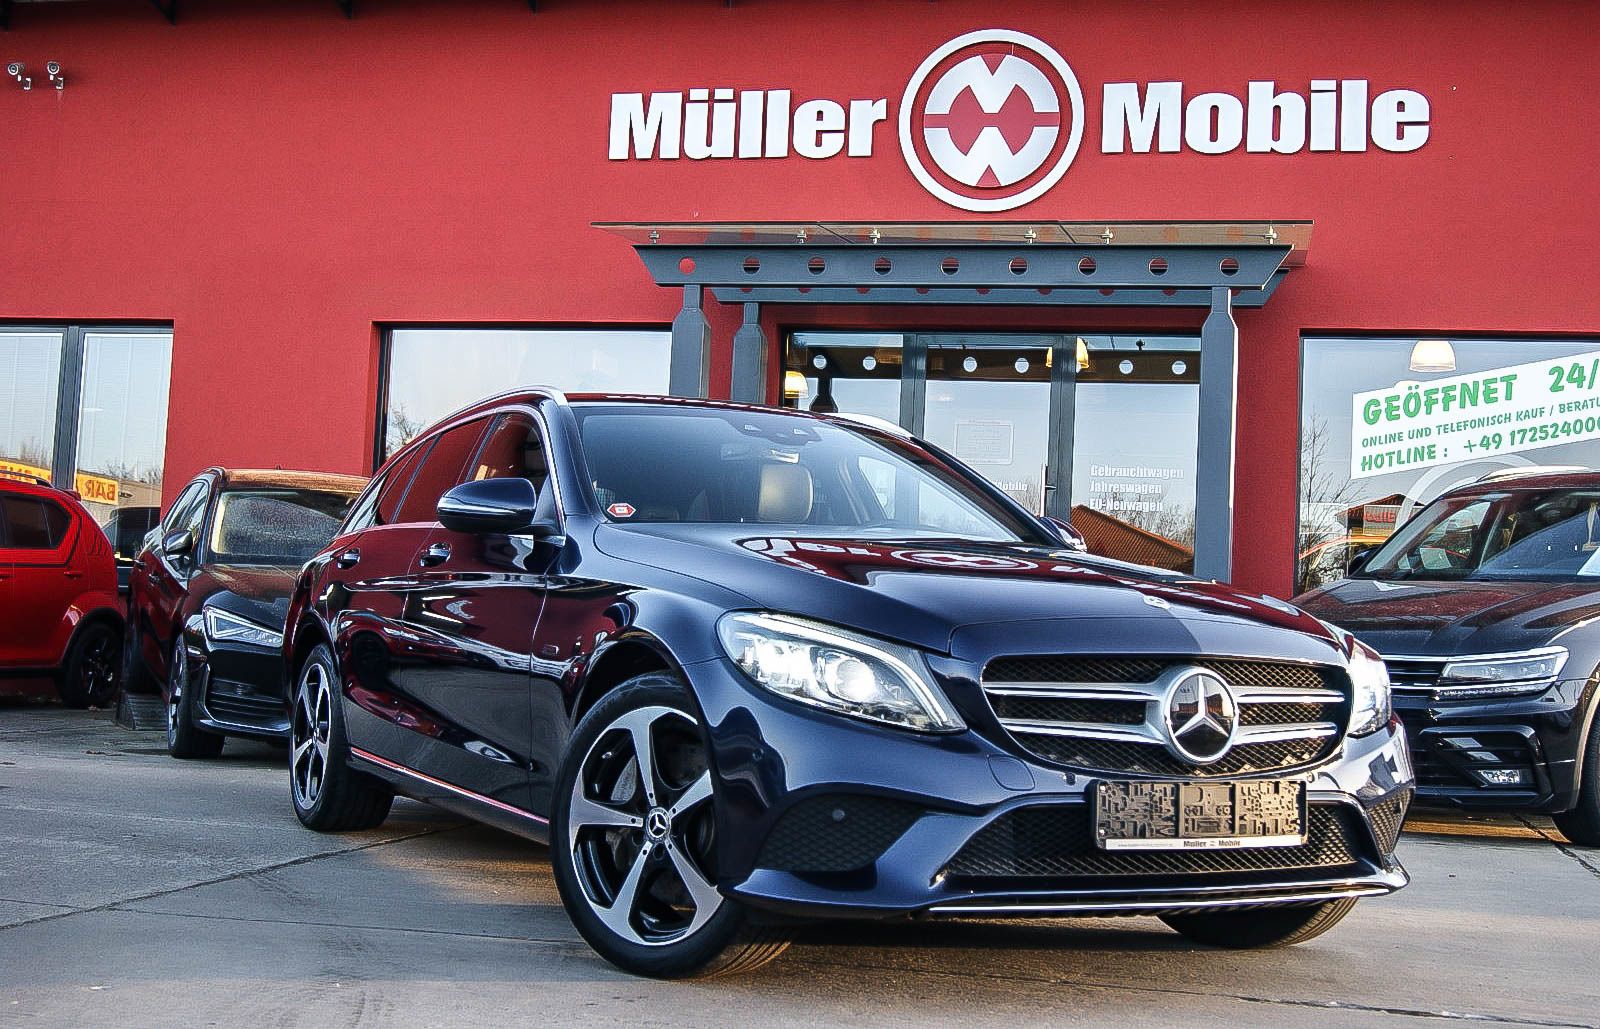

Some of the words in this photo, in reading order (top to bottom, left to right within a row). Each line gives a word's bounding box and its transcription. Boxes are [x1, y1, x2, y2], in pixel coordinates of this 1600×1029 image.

[609, 88, 887, 160] Müller
[1101, 79, 1431, 155] Mobile
[1363, 374, 1518, 426] GEÖFFNET
[1549, 358, 1599, 392] 24/
[1361, 431, 1404, 448] ONLINE
[1408, 427, 1432, 440] UND
[1436, 413, 1512, 435] TELEFONISCH
[1516, 407, 1546, 422] KAUF
[1090, 464, 1185, 480] Gebrauchtwagen
[1361, 444, 1437, 472] HOTLINE
[1463, 432, 1503, 454] +49
[1089, 498, 1164, 512] EU-Neuwagen
[1090, 481, 1162, 495] Jahreswagen
